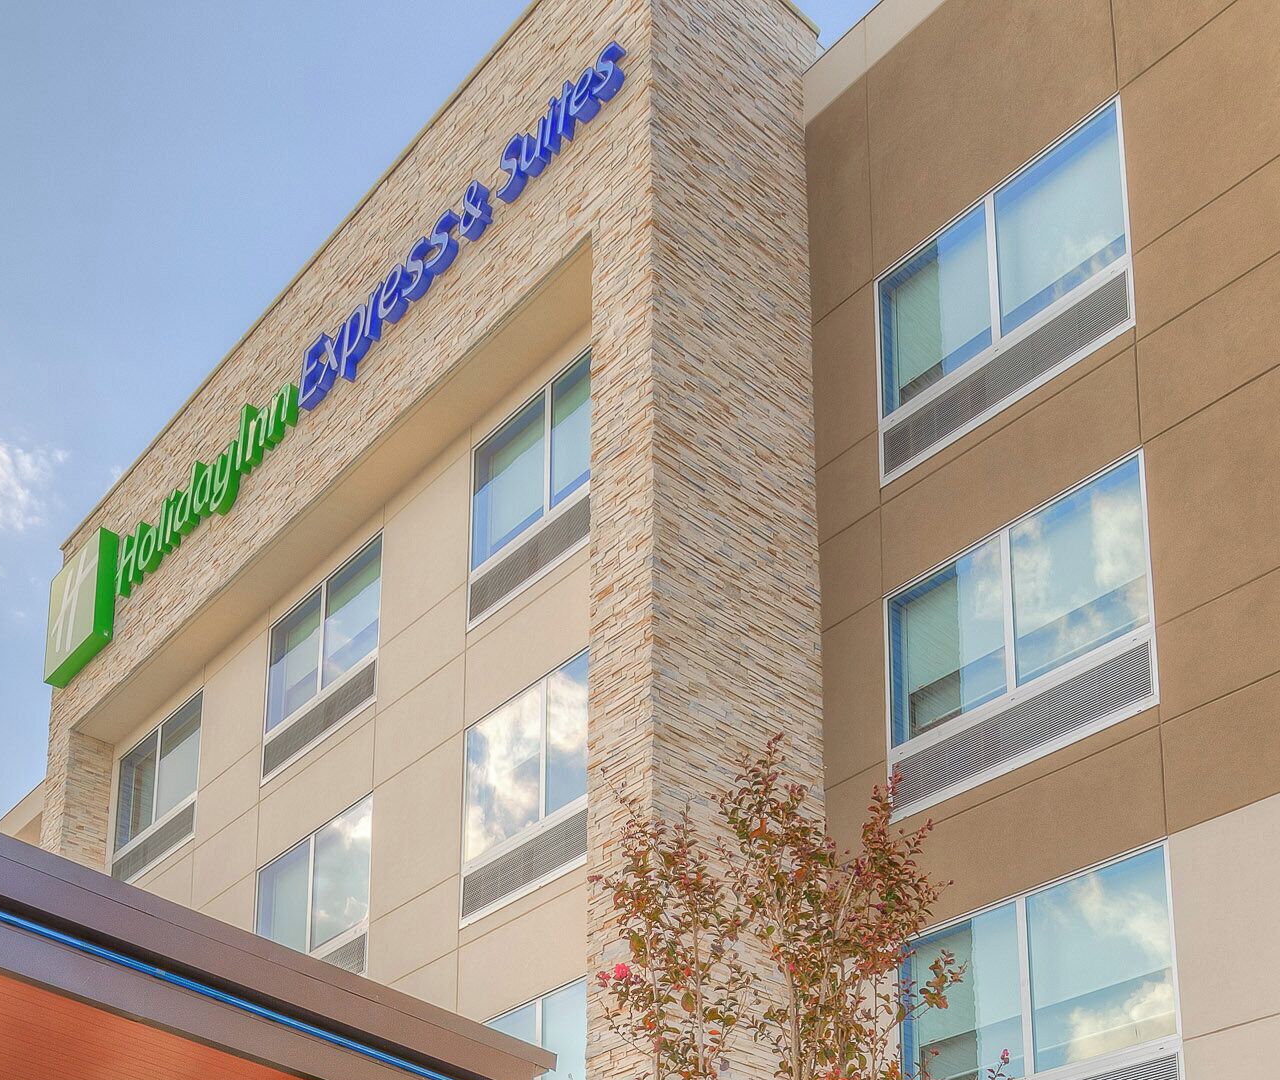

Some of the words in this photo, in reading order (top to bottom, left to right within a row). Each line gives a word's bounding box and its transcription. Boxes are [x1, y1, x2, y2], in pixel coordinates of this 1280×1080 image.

[115, 440, 241, 598] Holiday
[235, 382, 299, 475] Inn
[297, 208, 461, 412] Express
[459, 179, 493, 242] &
[496, 40, 627, 204] Suites
